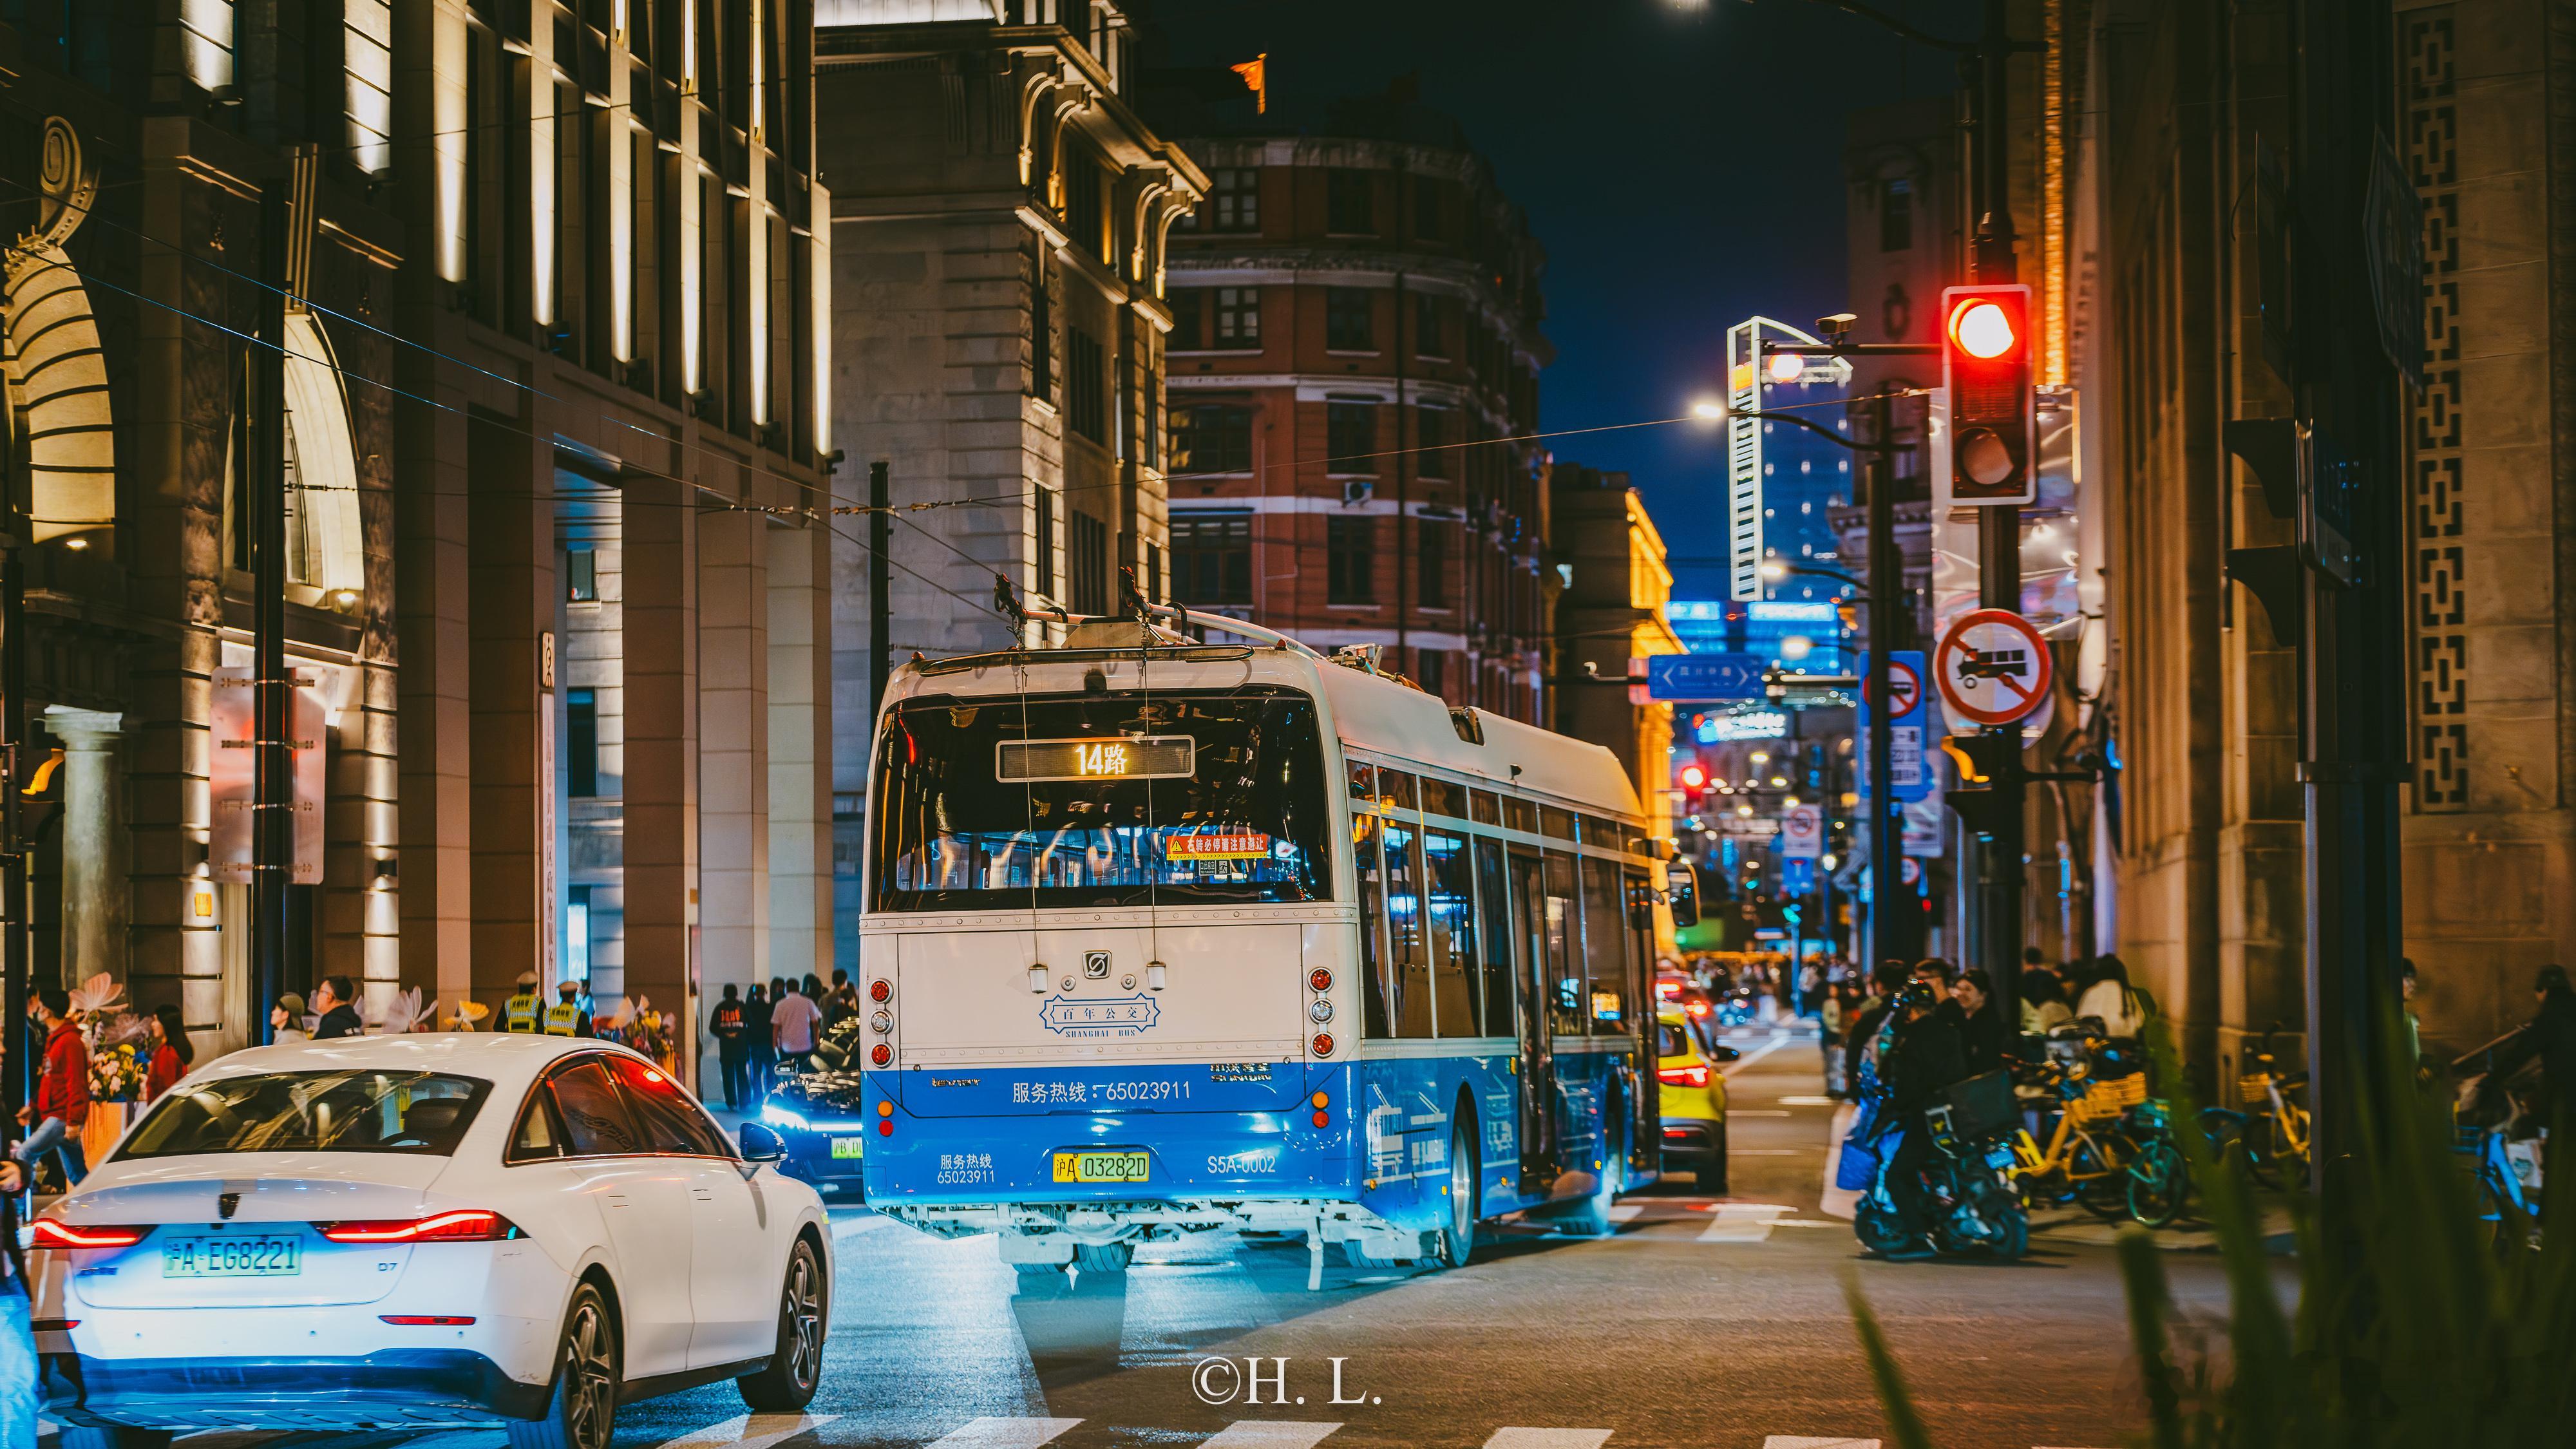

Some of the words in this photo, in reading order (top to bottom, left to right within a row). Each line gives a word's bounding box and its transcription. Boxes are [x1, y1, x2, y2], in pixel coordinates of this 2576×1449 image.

[1075, 744, 1128, 775] 14路
[1187, 837, 1264, 853] 右转必停请注意避让
[1064, 1007, 1138, 1020] 百年公交
[940, 1153, 992, 1170] 服务热线
[1208, 1155, 1276, 1174] S5A-0002
[937, 1170, 994, 1184] 65023911
[378, 1262, 398, 1271] D7
